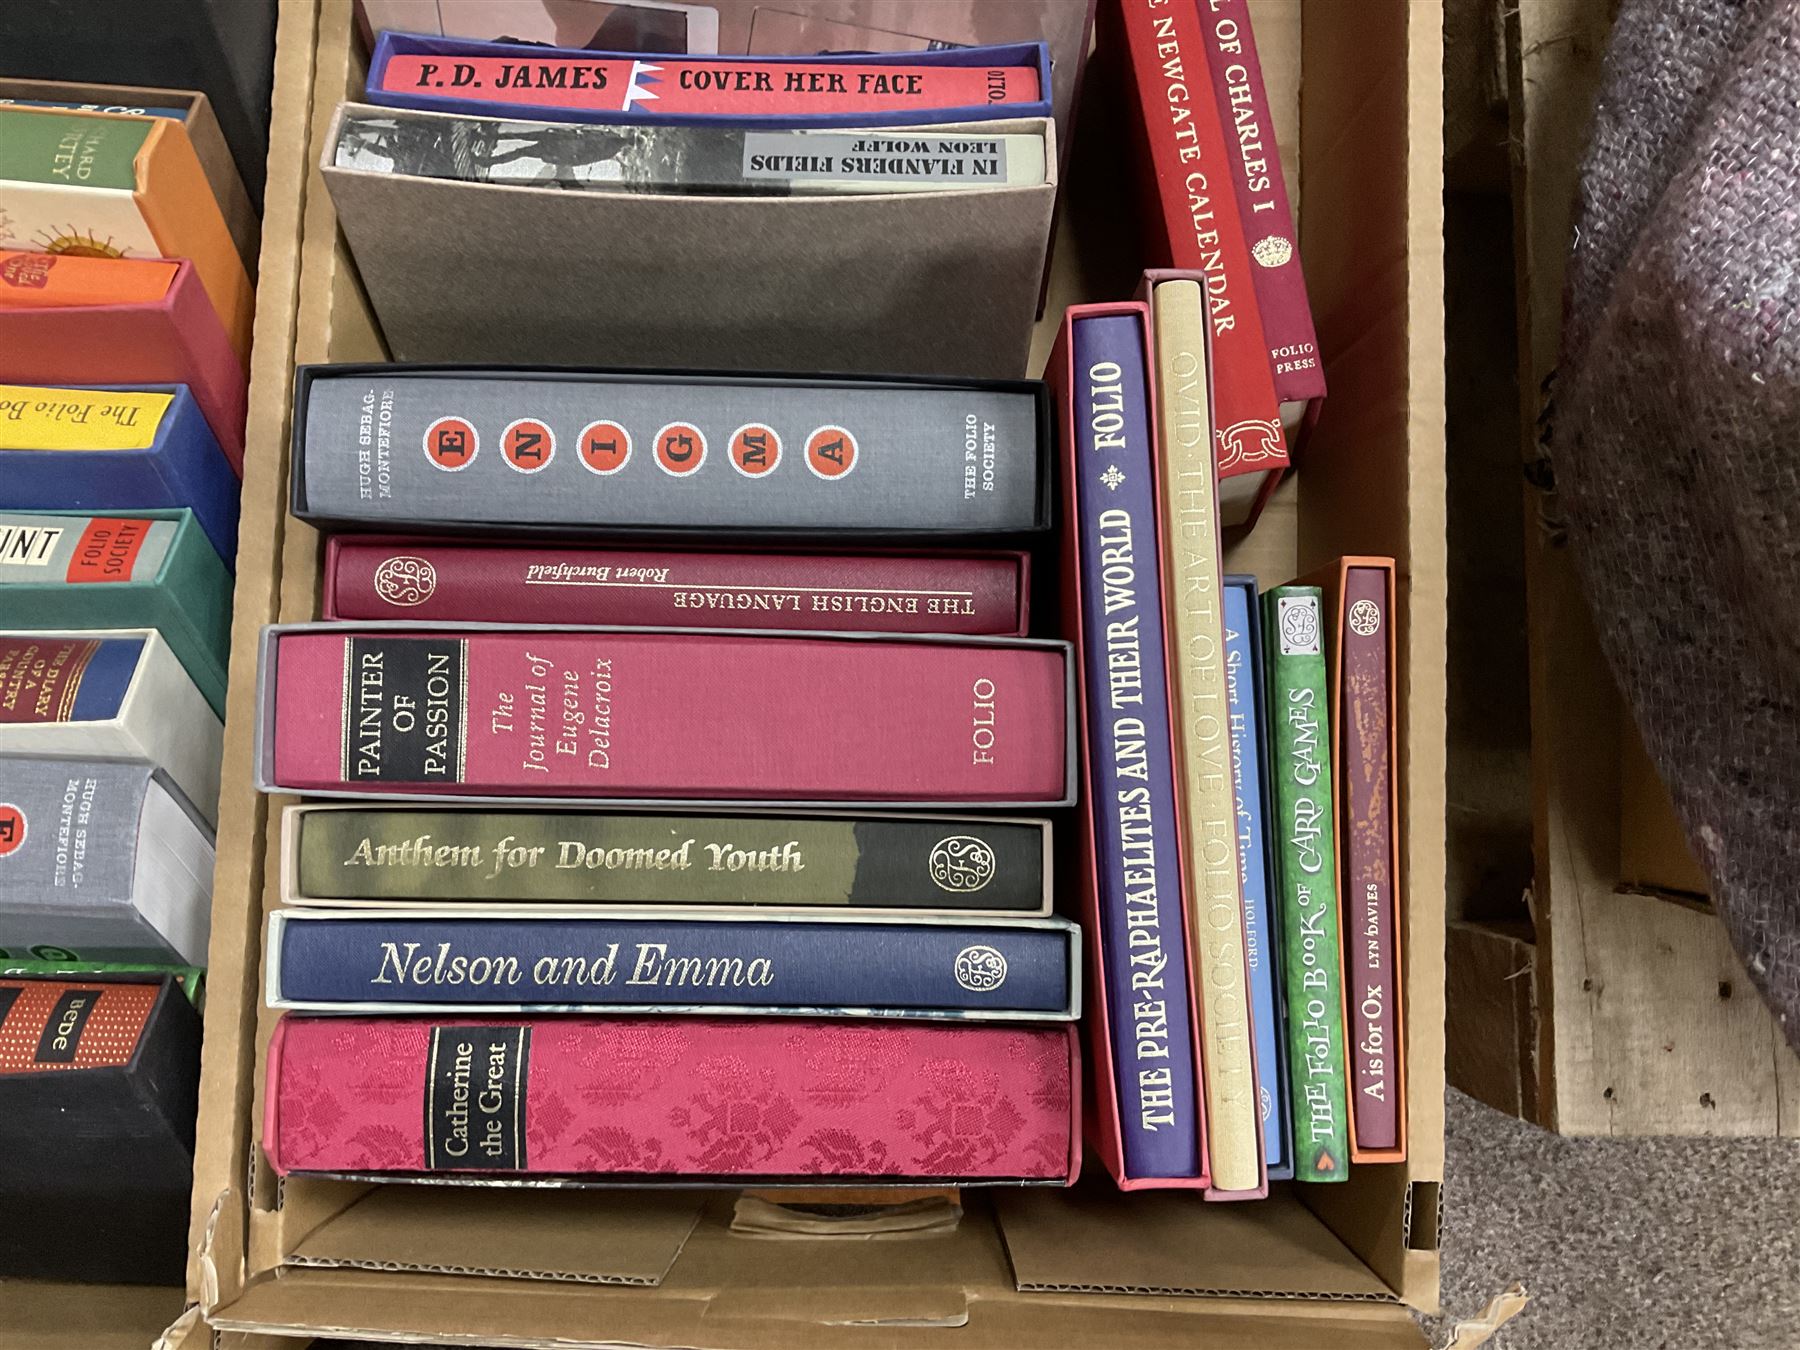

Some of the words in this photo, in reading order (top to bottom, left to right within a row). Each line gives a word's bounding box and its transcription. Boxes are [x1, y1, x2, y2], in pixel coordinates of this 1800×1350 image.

[1215, 18, 1243, 55] OF
[416, 64, 481, 88] P.D.
[495, 65, 608, 90] JAMES
[679, 70, 773, 92] COVER
[784, 72, 848, 94] HER
[857, 74, 923, 95] FACE
[987, 70, 1007, 105] OLIO
[852, 140, 930, 154] WOLFF
[938, 141, 998, 154] LEON
[1225, 64, 1270, 192] CHARLES
[750, 155, 833, 174] FIELDS
[841, 156, 964, 175] FLANDERS
[972, 159, 998, 175] IN
[1153, 16, 1201, 164] NEWGATE
[1185, 172, 1236, 337] CALENDAR
[1253, 200, 1275, 213] I
[1271, 343, 1314, 359] FOLIO
[1276, 358, 1316, 374] PRESS
[34, 401, 96, 424] Folio
[100, 406, 141, 427] The
[1089, 361, 1126, 451] FOLIO
[1171, 351, 1202, 449] OVID
[379, 389, 395, 499] MONTEFIORE
[965, 413, 977, 462] FOLIO
[982, 421, 996, 492] SOCIETY
[359, 456, 373, 500] HUGH
[964, 464, 977, 499] THE
[1177, 462, 1208, 538] THE
[80, 530, 111, 567] FOLIO
[104, 524, 141, 574] SOCIETY
[1099, 508, 1137, 616] WORLD
[526, 562, 612, 581] Burchfield
[615, 567, 670, 582] Robert
[1183, 550, 1213, 624] ART
[673, 592, 801, 611] LANGUAGE
[811, 595, 919, 614] ENGLISH
[927, 598, 976, 615] THE
[1225, 628, 1240, 642] A
[3, 645, 39, 712] COUNTRY
[31, 659, 46, 677] OF
[525, 651, 554, 678] of
[1107, 615, 1144, 710] THEIR
[1189, 634, 1217, 683] OF
[25, 680, 37, 690] A
[35, 668, 60, 717] DIARY
[358, 651, 384, 776] PAINTER
[393, 694, 416, 732] OF
[424, 653, 450, 775] PASSION
[492, 691, 515, 734] The
[523, 683, 549, 773] Journal
[556, 669, 585, 757] Eugene
[588, 657, 613, 769] Delacroix
[972, 678, 996, 765] FOLIO
[1113, 716, 1149, 781] AND
[1192, 690, 1225, 794] LOVE
[1287, 687, 1323, 786] GAMES
[76, 778, 97, 826] HUGH
[54, 778, 80, 887] MONTEFIORE
[1290, 797, 1325, 874] CARD
[343, 835, 484, 867] Anthem
[485, 836, 545, 879] for
[555, 838, 696, 871] Doomed
[703, 841, 805, 873] Youth
[1200, 816, 1235, 932] FOLIO
[1296, 883, 1313, 906] OF
[1363, 883, 1378, 937] DAVIES
[1117, 787, 1169, 1060] PRE-RAPHAELITES
[370, 942, 523, 985] Nelson
[533, 942, 621, 986] and
[625, 943, 775, 987] Emma
[1299, 902, 1330, 992] BOOK
[1367, 939, 1380, 969] LYN
[1361, 984, 1383, 1018] Ox
[1302, 998, 1334, 1081] FOLIO
[1360, 1023, 1383, 1055] for
[479, 1042, 507, 1114] Great
[1361, 1058, 1384, 1076] is
[445, 1042, 473, 1157] Catherine
[1138, 1067, 1175, 1132] THE
[1304, 1081, 1335, 1144] THE
[1363, 1080, 1385, 1102] A
[480, 1120, 503, 1157] the
